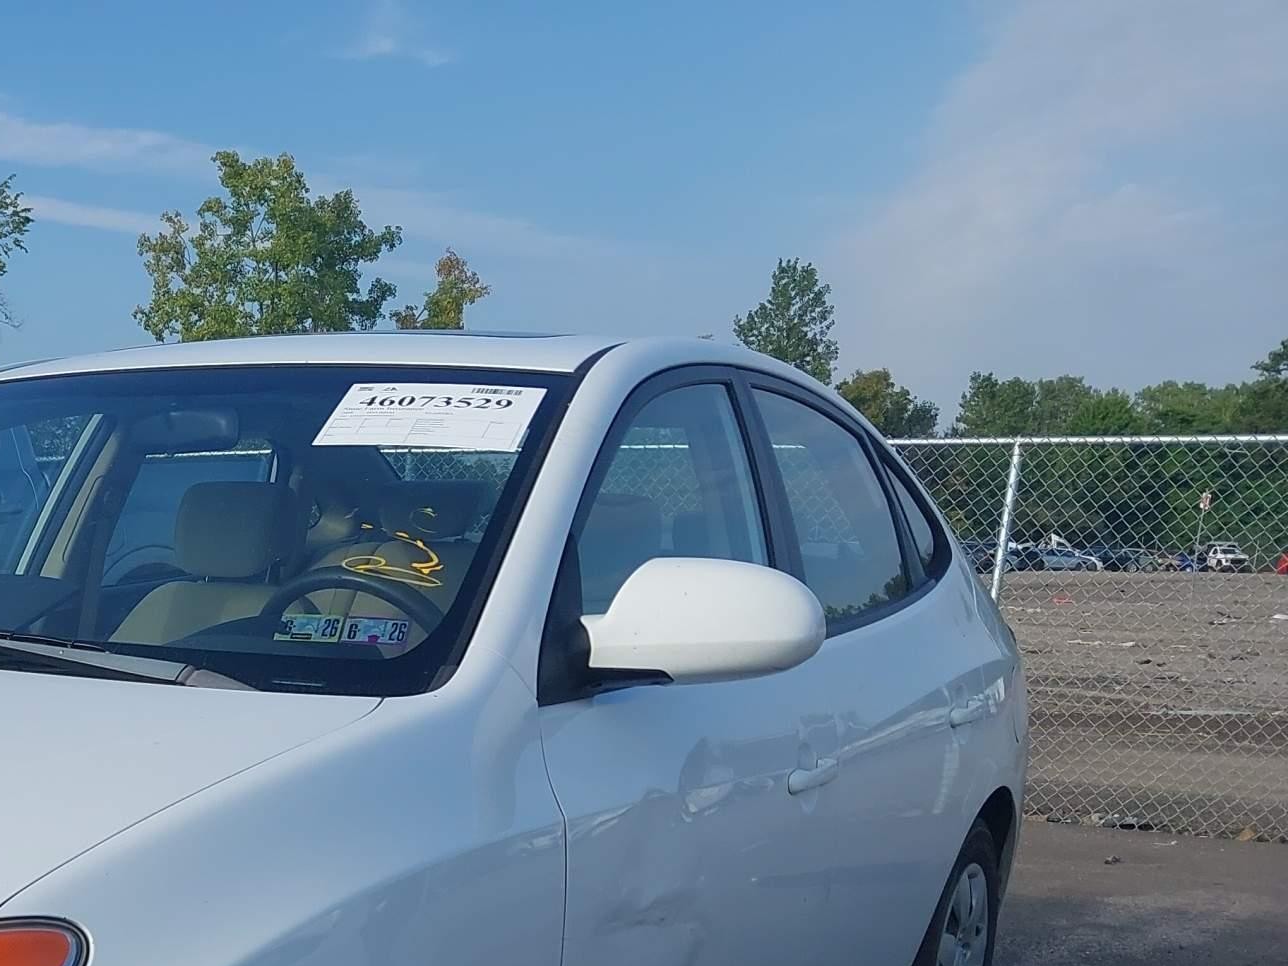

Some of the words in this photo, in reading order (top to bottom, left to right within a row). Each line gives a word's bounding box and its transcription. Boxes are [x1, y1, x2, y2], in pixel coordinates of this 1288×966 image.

[359, 395, 514, 410] 46073529
[320, 618, 340, 638] 26
[388, 622, 408, 641] 26
